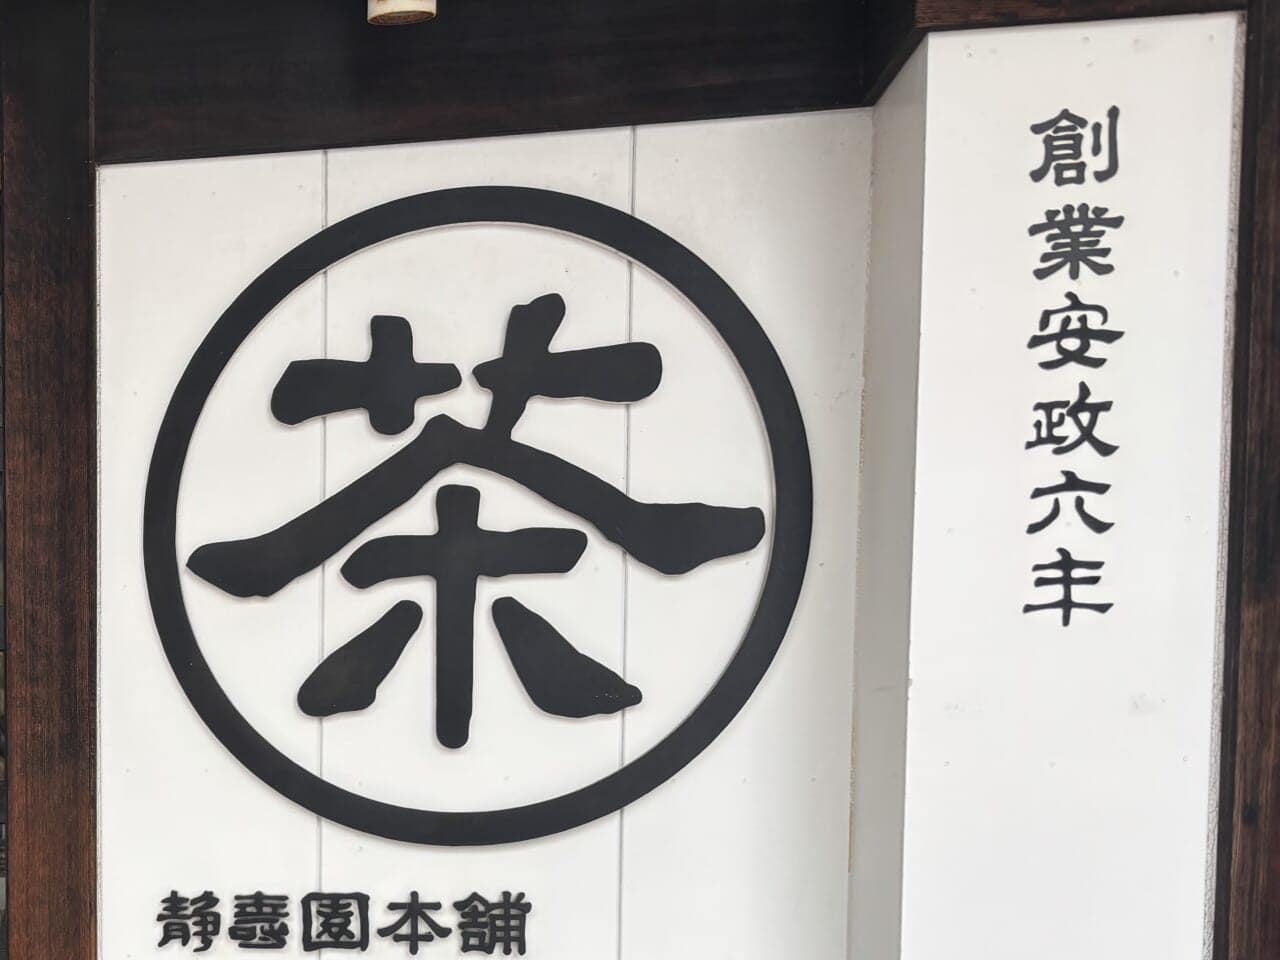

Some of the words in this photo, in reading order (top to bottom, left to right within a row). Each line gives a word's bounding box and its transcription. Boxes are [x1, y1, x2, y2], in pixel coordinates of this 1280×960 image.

[185, 292, 766, 749] 茶
[1022, 104, 1126, 627] 創業安政六年
